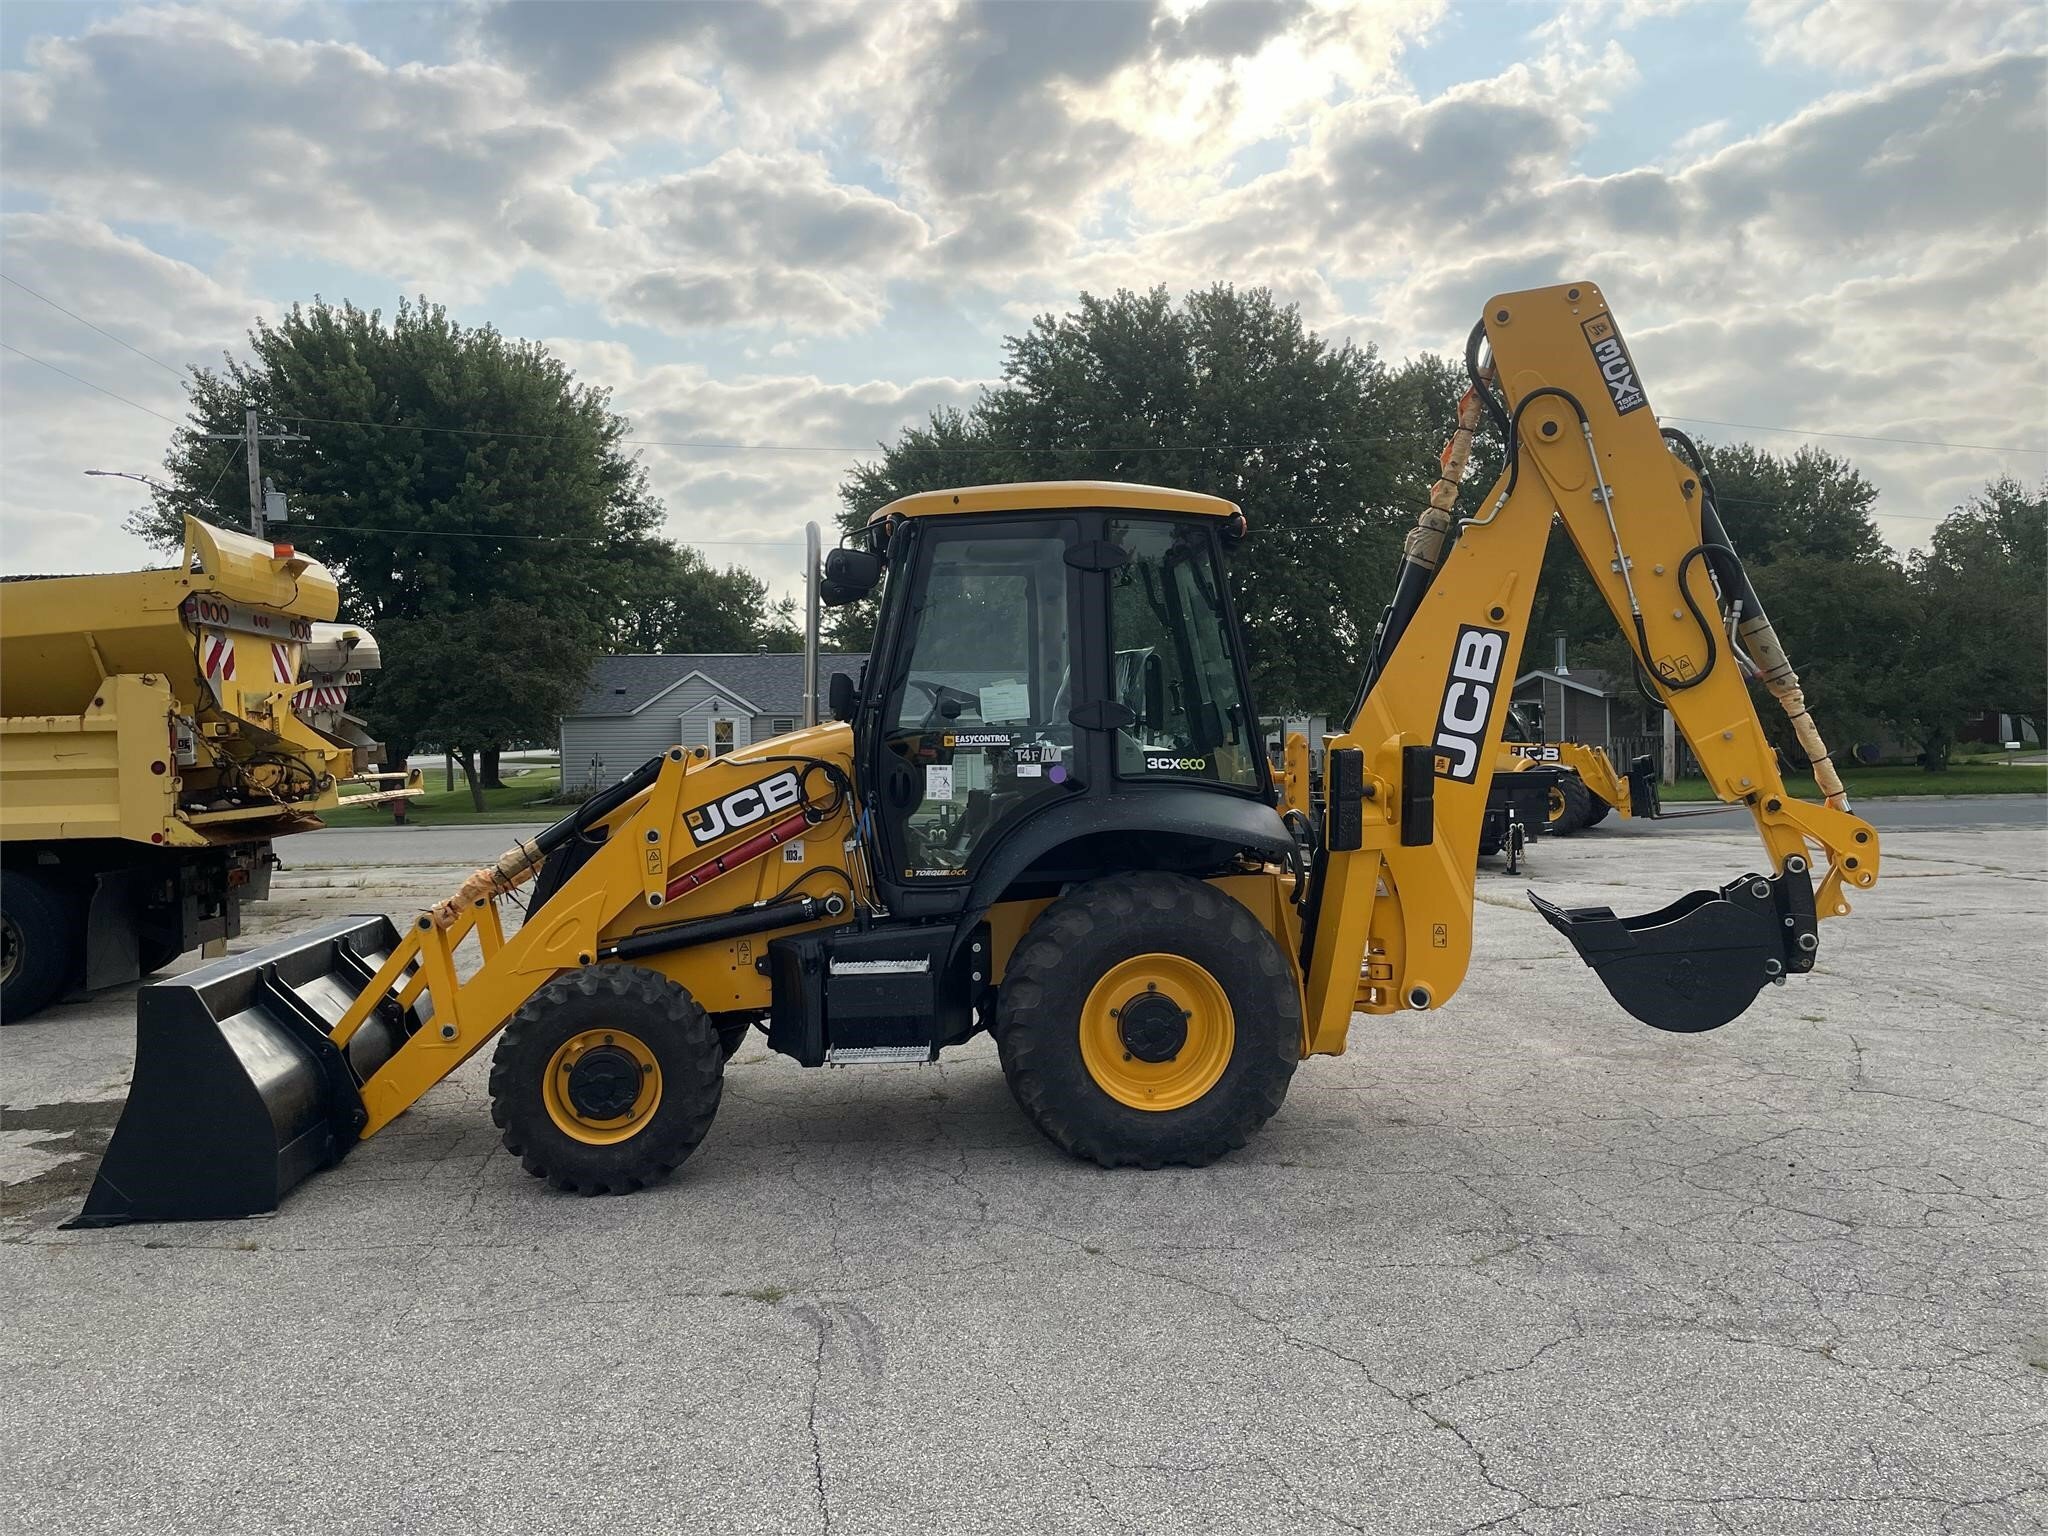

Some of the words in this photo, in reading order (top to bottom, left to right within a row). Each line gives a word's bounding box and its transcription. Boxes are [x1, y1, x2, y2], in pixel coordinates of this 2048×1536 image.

[1596, 339, 1640, 400] 3CX
[1437, 631, 1502, 778] JCB
[955, 735, 1010, 744] EASYCONTROL
[1512, 747, 1559, 760] JCB
[1147, 757, 1205, 771] 3CXeco
[693, 772, 799, 842] JCB
[785, 850, 798, 861] 103
